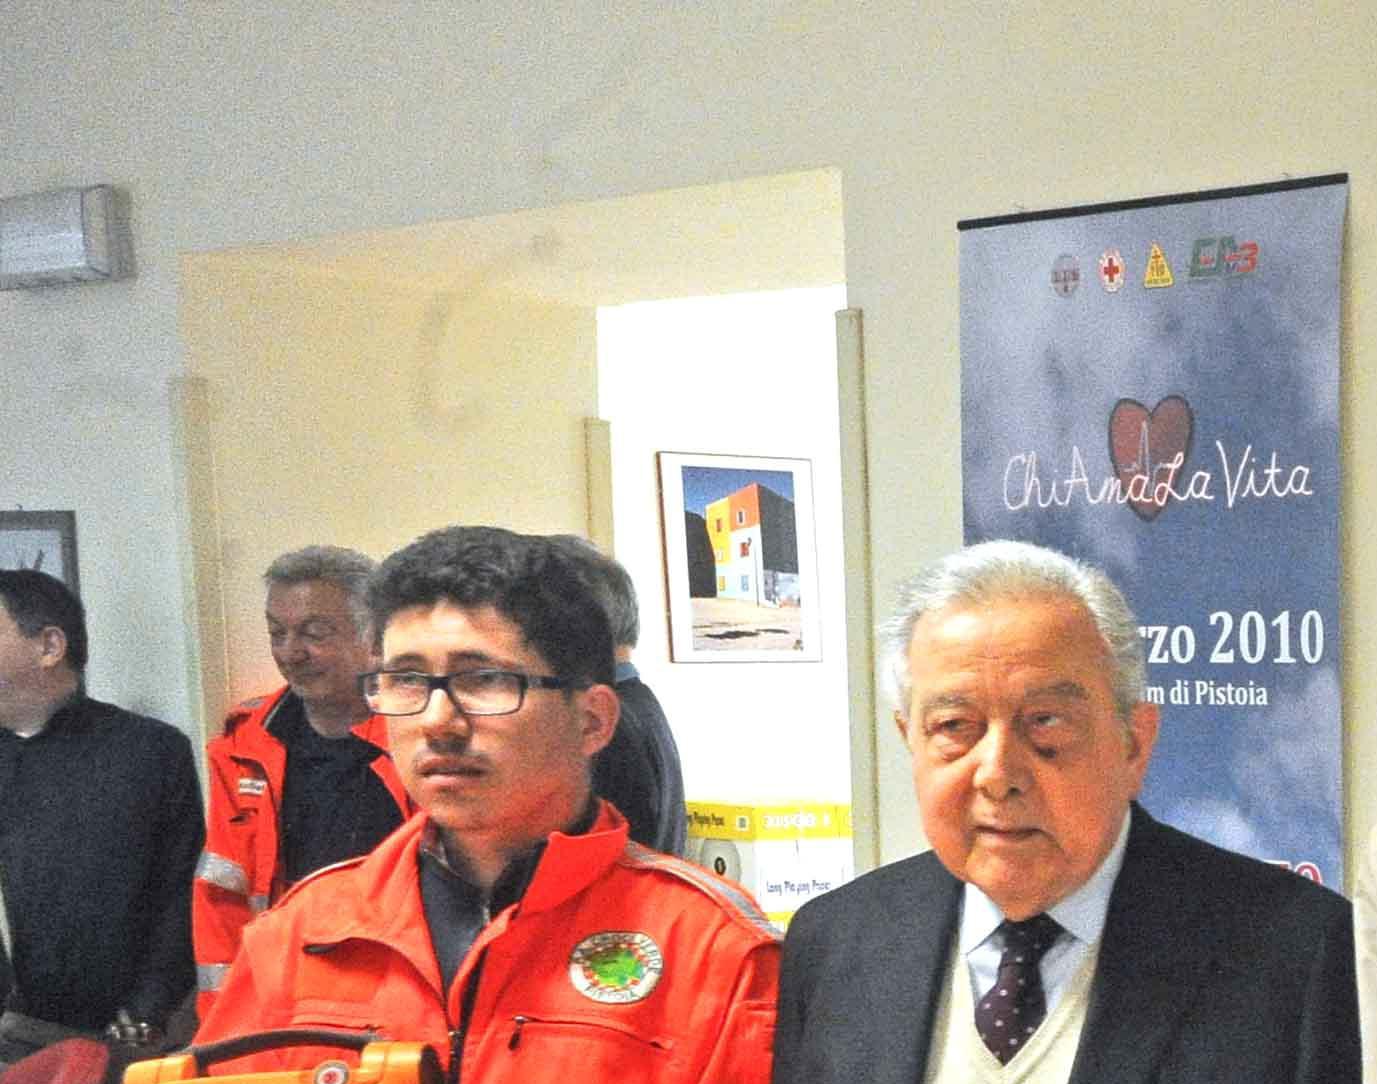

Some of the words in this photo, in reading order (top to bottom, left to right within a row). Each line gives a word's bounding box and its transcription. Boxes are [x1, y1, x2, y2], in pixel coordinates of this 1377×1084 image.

[1208, 610, 1325, 665] 2010
[1169, 679, 1190, 705] di
[1195, 679, 1268, 706] Pistoia
